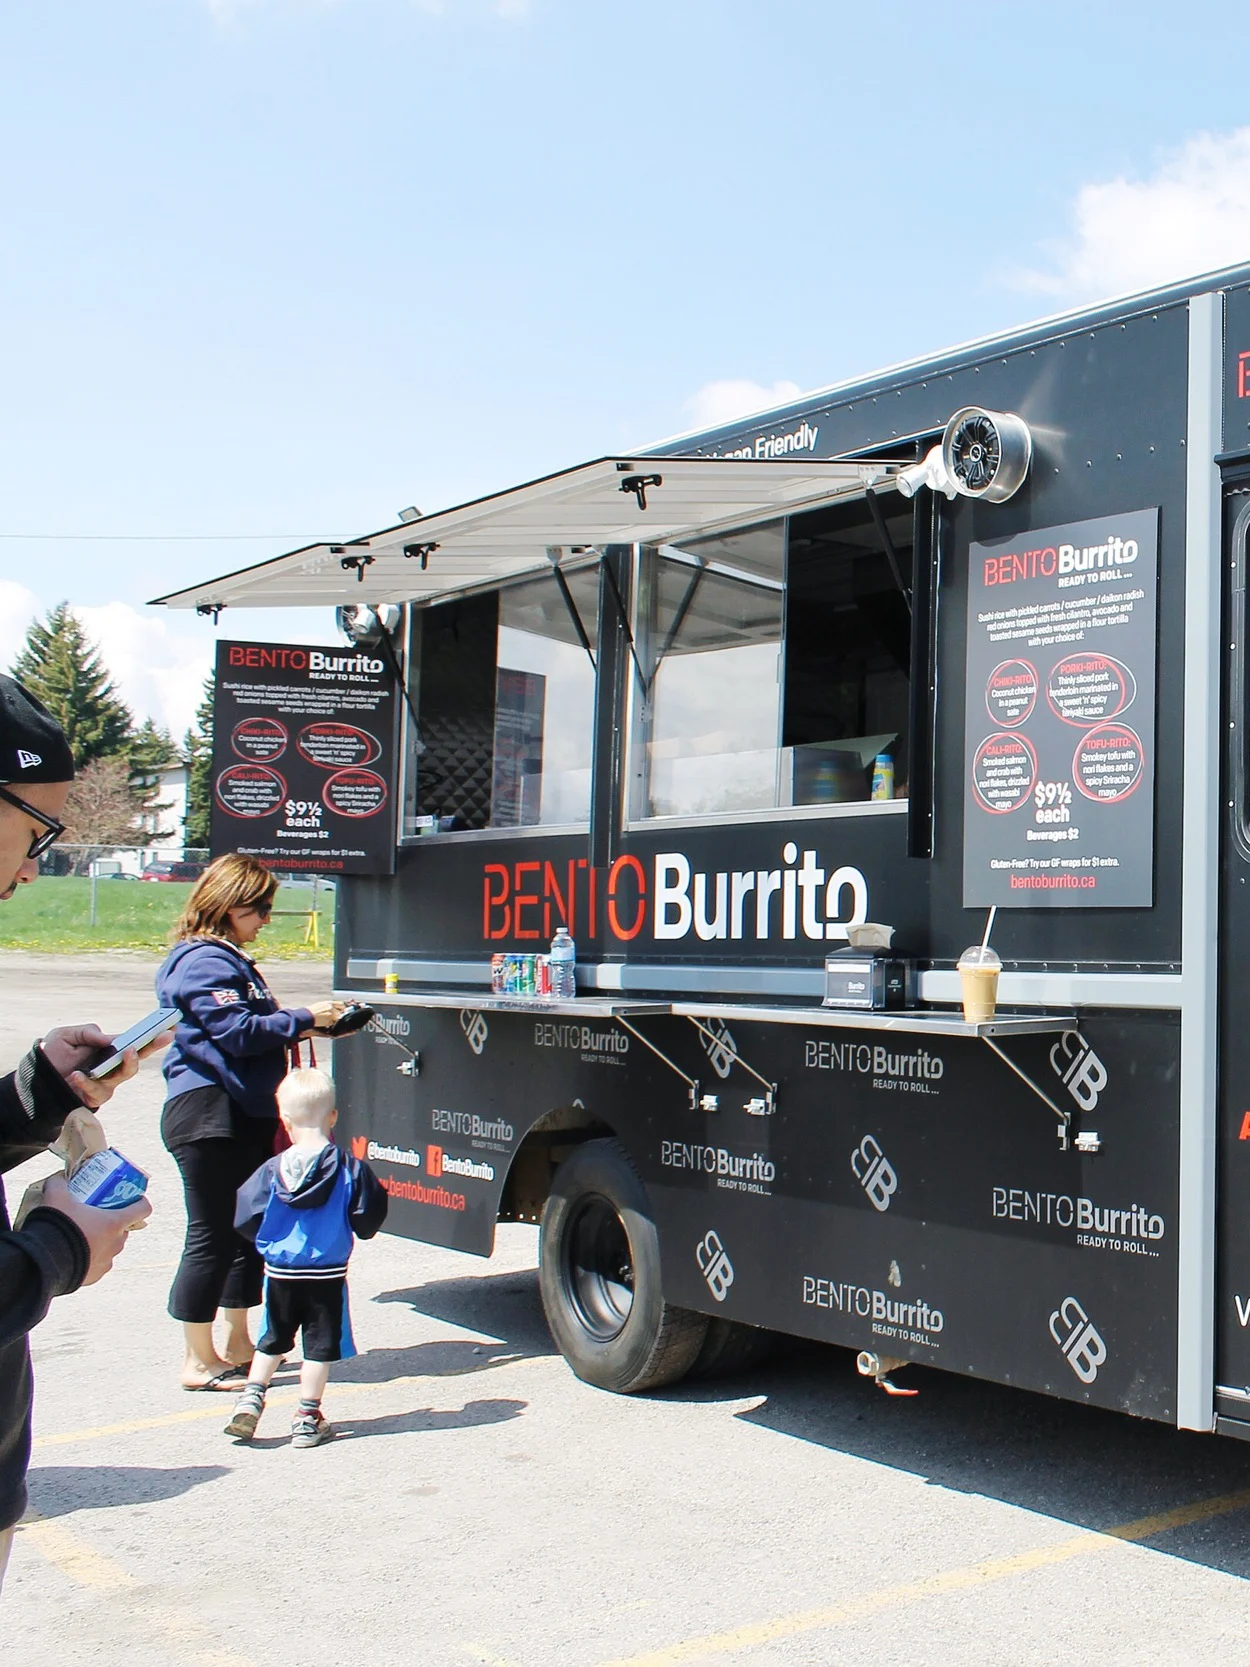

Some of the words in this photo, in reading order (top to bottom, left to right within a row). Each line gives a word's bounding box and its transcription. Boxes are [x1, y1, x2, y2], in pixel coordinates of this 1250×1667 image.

[755, 423, 818, 459] Friendly
[983, 547, 1056, 587] BENTO
[1058, 535, 1139, 574] Burrito
[1058, 574, 1086, 588] READY
[1086, 573, 1099, 584] TO
[1018, 604, 1038, 618] pickled
[1039, 602, 1060, 613] carrots
[1064, 597, 1096, 609] cucumber
[1100, 593, 1122, 604] daikon
[1123, 589, 1144, 601] radish
[996, 620, 1015, 630] onions
[1016, 615, 1036, 628] topped
[1036, 614, 1049, 624] with
[1050, 611, 1065, 622] fresh
[1091, 604, 1120, 616] avocado
[1120, 602, 1132, 612] and
[989, 630, 1011, 642] toasted
[1011, 628, 1034, 639] sesame
[1034, 624, 1053, 635] seeds
[1052, 621, 1079, 633] wrapped
[1079, 620, 1086, 629] in
[1086, 620, 1091, 628] a
[1092, 618, 1107, 627] flour
[1107, 615, 1128, 625] tortilla
[1027, 636, 1041, 647] with
[1041, 636, 1054, 646] your
[1054, 633, 1075, 643] choice
[229, 647, 306, 670] BENTO
[309, 651, 384, 673] Burrito
[309, 672, 335, 680] READY
[337, 673, 347, 681] TO
[1057, 675, 1075, 685] Thinly
[1075, 673, 1094, 684] sliced
[1094, 672, 1109, 683] pork
[991, 688, 1014, 698] Coconut
[1111, 682, 1118, 691] in
[1008, 696, 1028, 707] peanut
[1063, 697, 1082, 707] sweet
[1089, 694, 1107, 705] spicy
[1084, 707, 1104, 716] sauce
[1086, 737, 1131, 750] TOFU-RITO:
[982, 757, 1005, 767] Smoked
[1005, 756, 1026, 765] salmon
[1080, 752, 1106, 763] Smokey
[1106, 751, 1121, 761] tofu
[1121, 750, 1135, 759] with
[985, 768, 997, 777] and
[997, 767, 1010, 776] crab
[1010, 767, 1023, 775] with
[1082, 765, 1095, 774] nori
[1095, 763, 1114, 773] flakes
[1114, 762, 1128, 772] and
[978, 779, 990, 789] nori
[1085, 777, 1102, 787] spicy
[1102, 775, 1130, 785] Sriracha
[987, 789, 999, 798] with
[1098, 789, 1117, 798] mayo
[1035, 804, 1070, 824] each
[286, 815, 320, 827] each
[277, 830, 317, 839] Beverages
[1026, 830, 1067, 841] Beverages
[1067, 828, 1079, 840] $2
[990, 859, 1028, 869] Gluten-Free?
[1030, 859, 1039, 869] Try
[1039, 860, 1050, 868] our
[1050, 858, 1060, 868] GF
[1060, 859, 1080, 869] wraps
[1081, 857, 1091, 867] for
[1091, 857, 1099, 867] $1
[1099, 858, 1119, 867] extra.
[1010, 874, 1096, 889] bentoburrito.ca
[482, 853, 647, 942] BENTO
[652, 841, 869, 942] Burrito
[534, 1023, 580, 1049] BENTO
[580, 1027, 629, 1053] Burrito
[805, 1040, 871, 1073] BENTO
[873, 1046, 944, 1079] Burrito
[873, 1078, 898, 1090] READY
[899, 1081, 909, 1091] TO
[432, 1109, 471, 1135] BENTO
[472, 1114, 513, 1141] Burrito
[367, 1141, 420, 1167] @bentoburrito
[442, 1154, 494, 1181] BentoBurrito
[661, 1140, 716, 1173] BENTO
[717, 1148, 775, 1182] Burrito
[717, 1178, 737, 1189] READY
[739, 1182, 747, 1191] TO
[993, 1187, 1074, 1227] BENTO
[1076, 1198, 1165, 1240] Burrito
[1077, 1234, 1107, 1249] READY
[1108, 1239, 1121, 1251] TO
[803, 1276, 870, 1316] BENTO
[872, 1290, 944, 1332] Burrito
[872, 1323, 897, 1336] READY
[899, 1329, 909, 1340] TO
